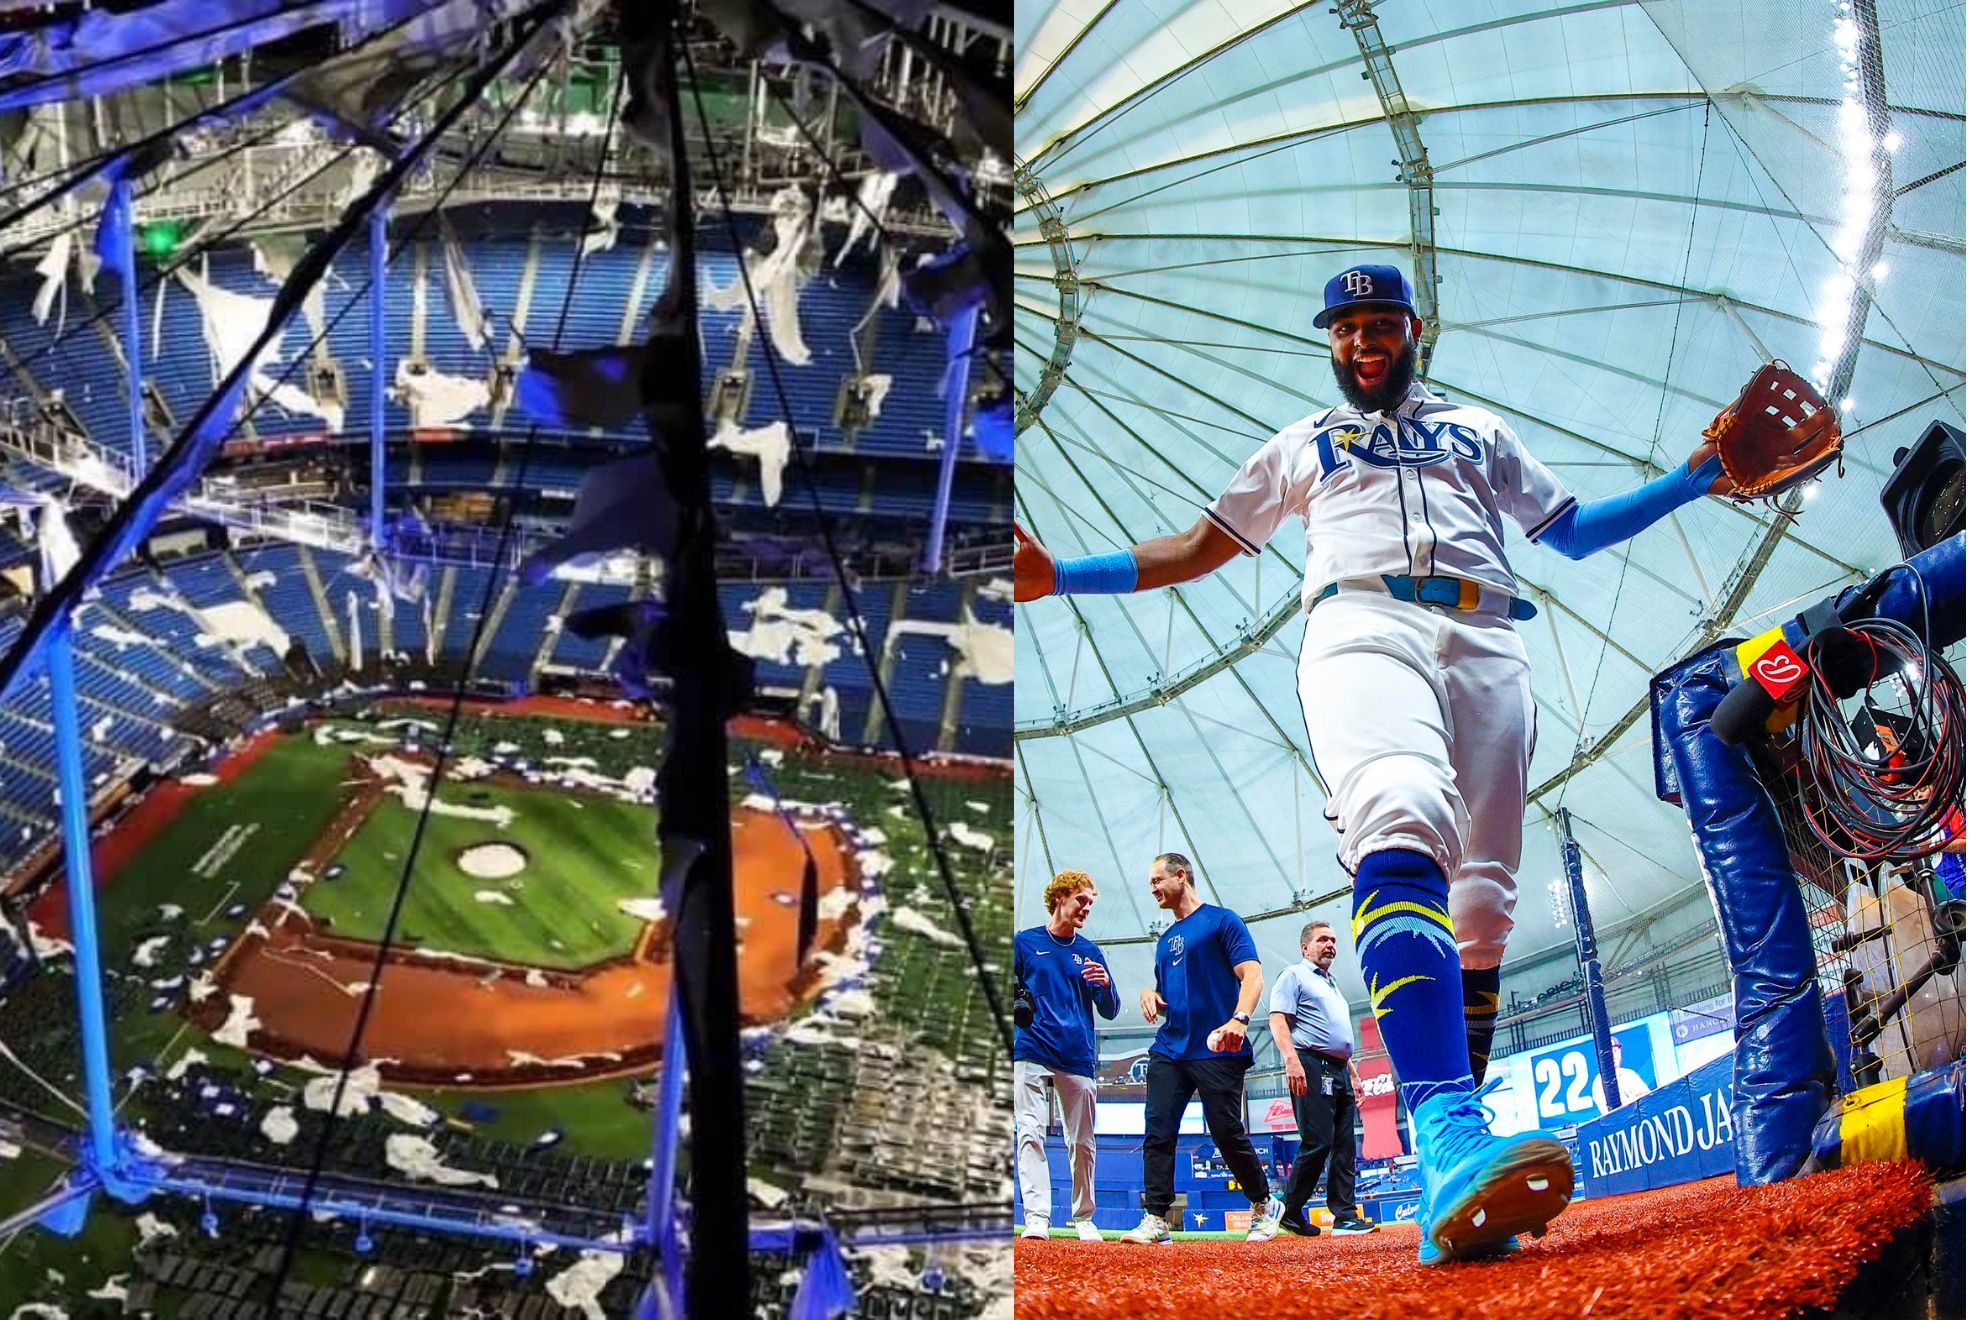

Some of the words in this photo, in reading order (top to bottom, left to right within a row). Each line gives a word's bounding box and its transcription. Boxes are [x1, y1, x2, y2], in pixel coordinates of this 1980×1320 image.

[1340, 270, 1374, 298] TB
[1309, 415, 1485, 485] RAYS
[1535, 1050, 1594, 1119] 22
[1588, 1105, 1694, 1179] RAYMOND
[1696, 1084, 1734, 1151] JA
